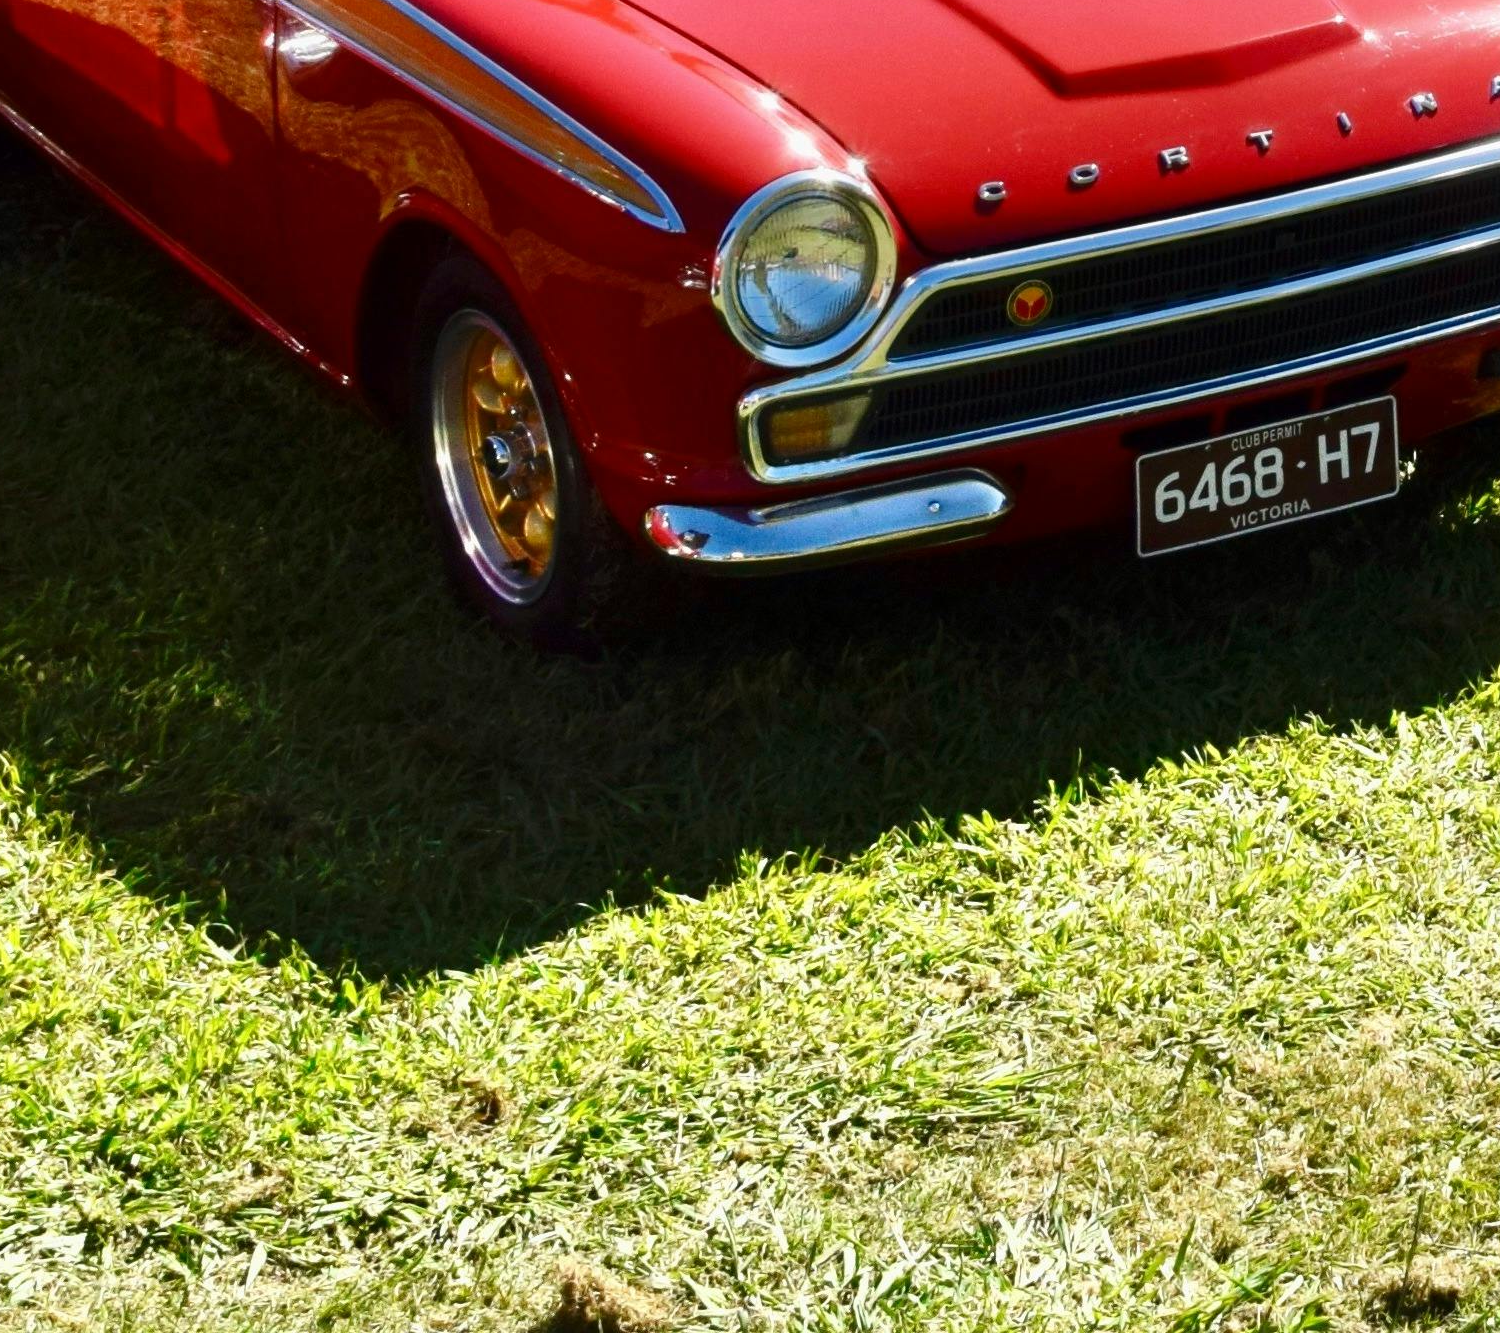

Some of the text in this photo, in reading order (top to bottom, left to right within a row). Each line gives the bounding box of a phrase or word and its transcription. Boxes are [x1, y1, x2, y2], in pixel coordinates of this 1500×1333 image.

[1231, 422, 1304, 452] CLUB PERMIT
[1230, 498, 1312, 529] VICTORIA
